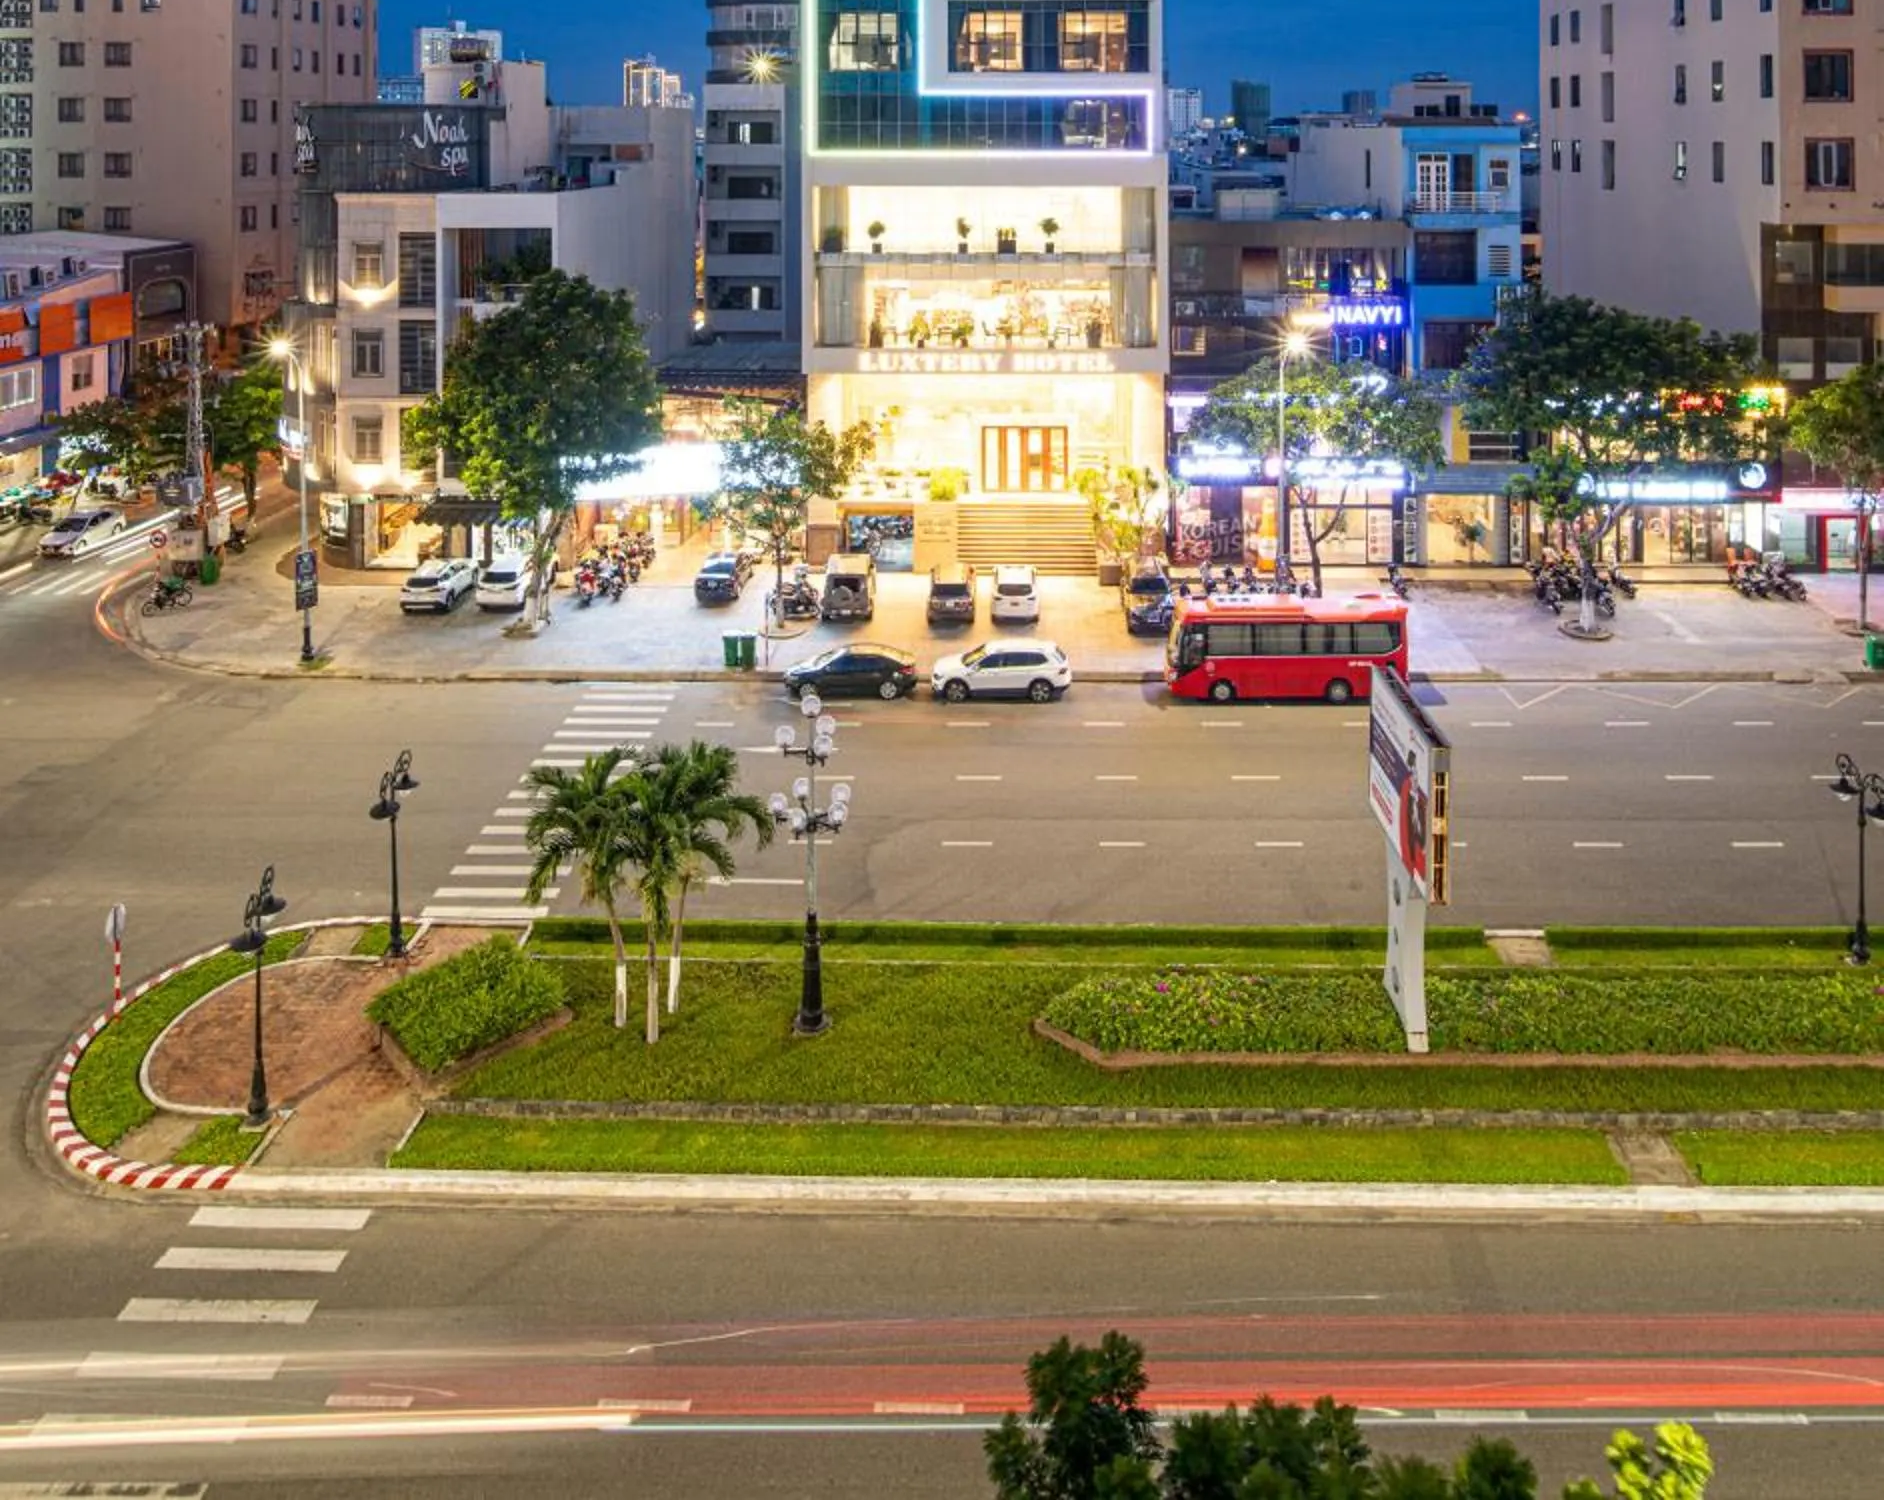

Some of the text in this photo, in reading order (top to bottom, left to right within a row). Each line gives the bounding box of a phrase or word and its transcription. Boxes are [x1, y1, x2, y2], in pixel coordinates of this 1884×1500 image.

[411, 108, 469, 148] Noah
[440, 146, 469, 177] spa
[1011, 352, 1116, 372] HOTEL
